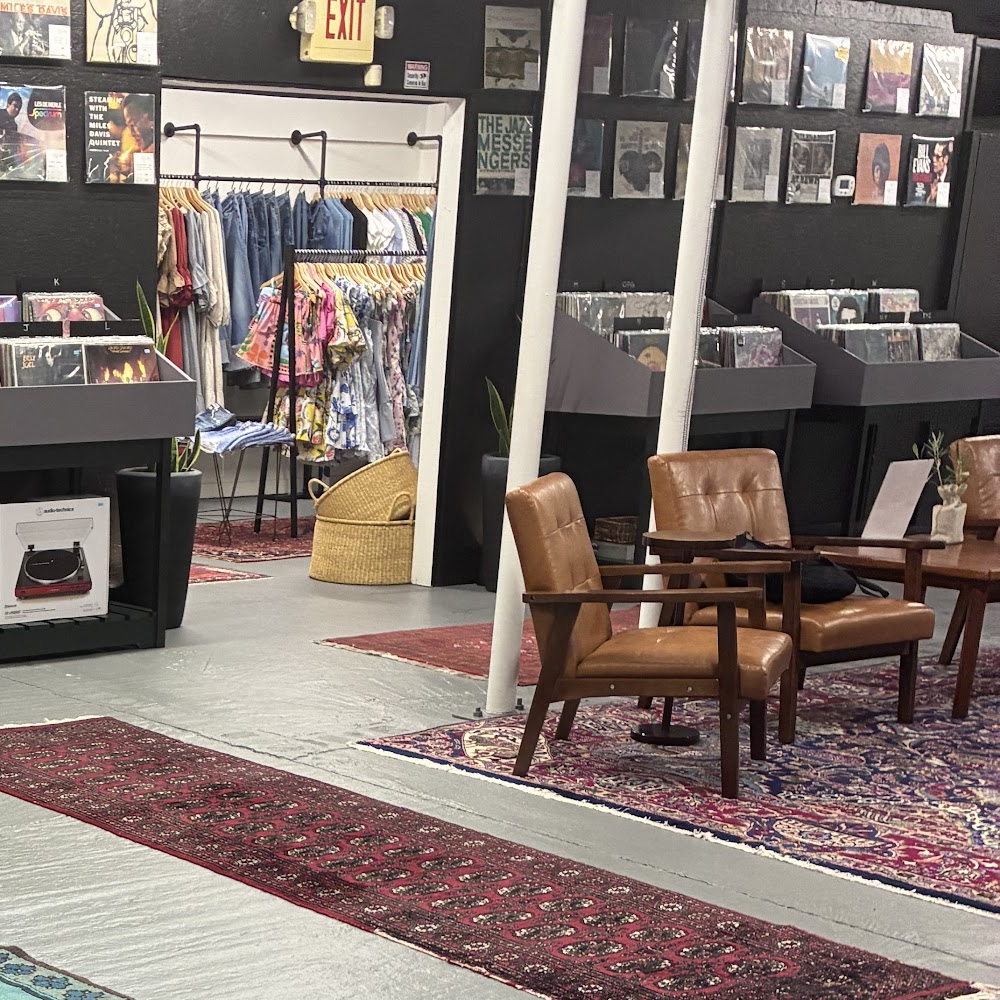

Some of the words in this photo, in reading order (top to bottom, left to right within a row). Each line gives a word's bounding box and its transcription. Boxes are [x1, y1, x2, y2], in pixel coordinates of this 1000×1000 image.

[0, 3, 34, 14] MILES
[38, 5, 67, 16] DAVIS
[325, 0, 366, 41] EXIT
[29, 107, 62, 119] Spectrum
[478, 115, 503, 133] THE
[89, 138, 121, 147] QUINTET
[478, 133, 532, 151] MESSE
[917, 143, 929, 158] BILL
[478, 151, 530, 169] NGERS
[912, 157, 931, 174] EVANS
[53, 278, 60, 286] K
[22, 323, 30, 332] J
[104, 321, 111, 331] L
